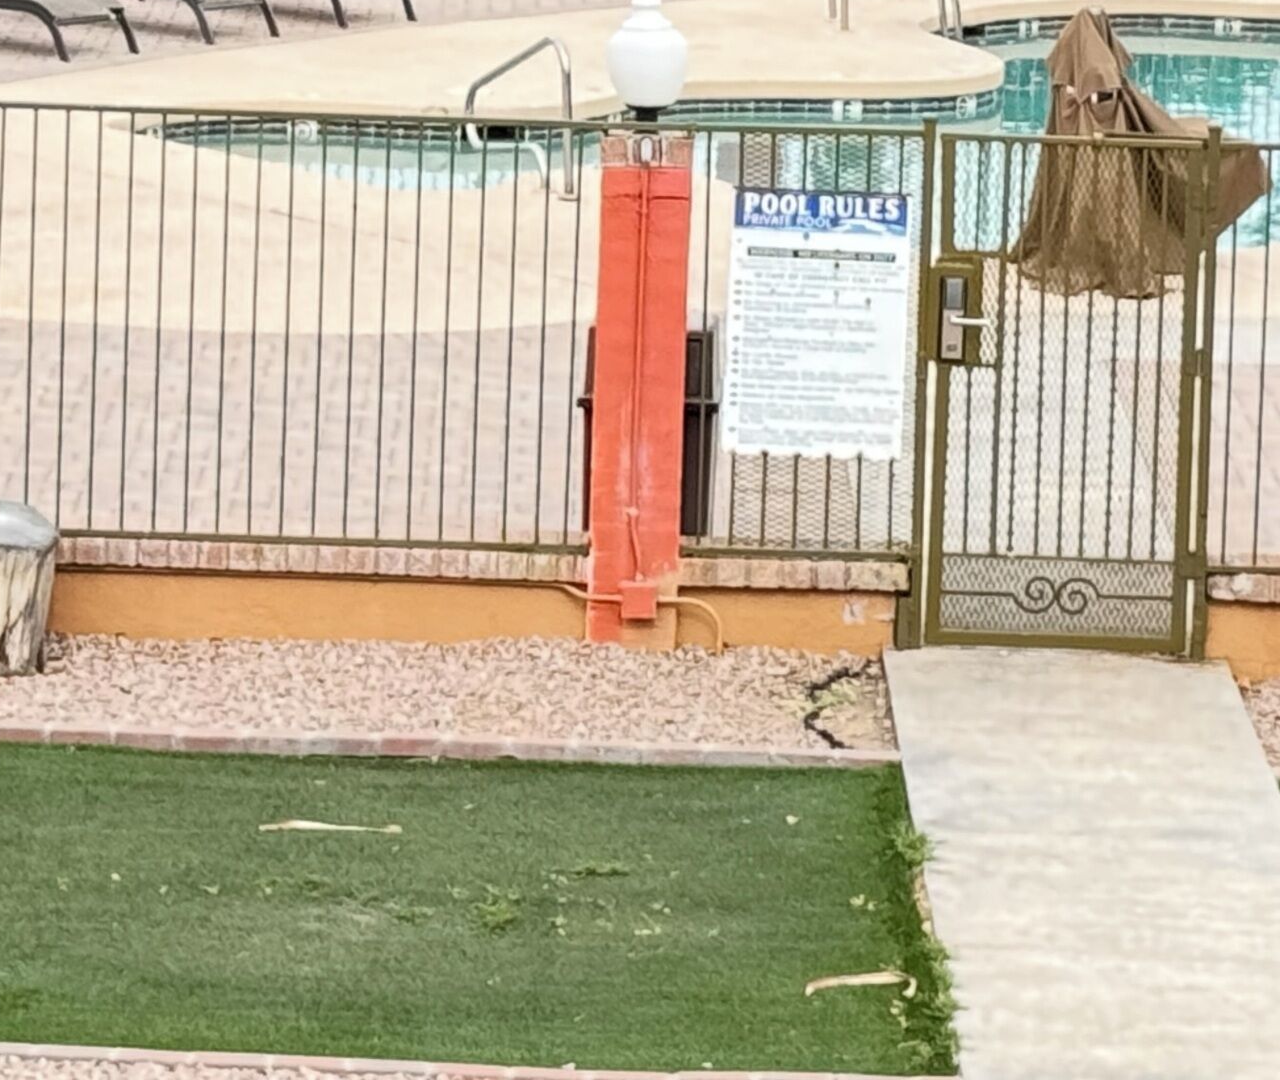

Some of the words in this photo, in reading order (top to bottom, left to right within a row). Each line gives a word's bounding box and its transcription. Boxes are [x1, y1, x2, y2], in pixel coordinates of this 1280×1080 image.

[744, 191, 812, 216] POOL
[819, 195, 900, 221] RULES
[796, 215, 832, 229] POOL
